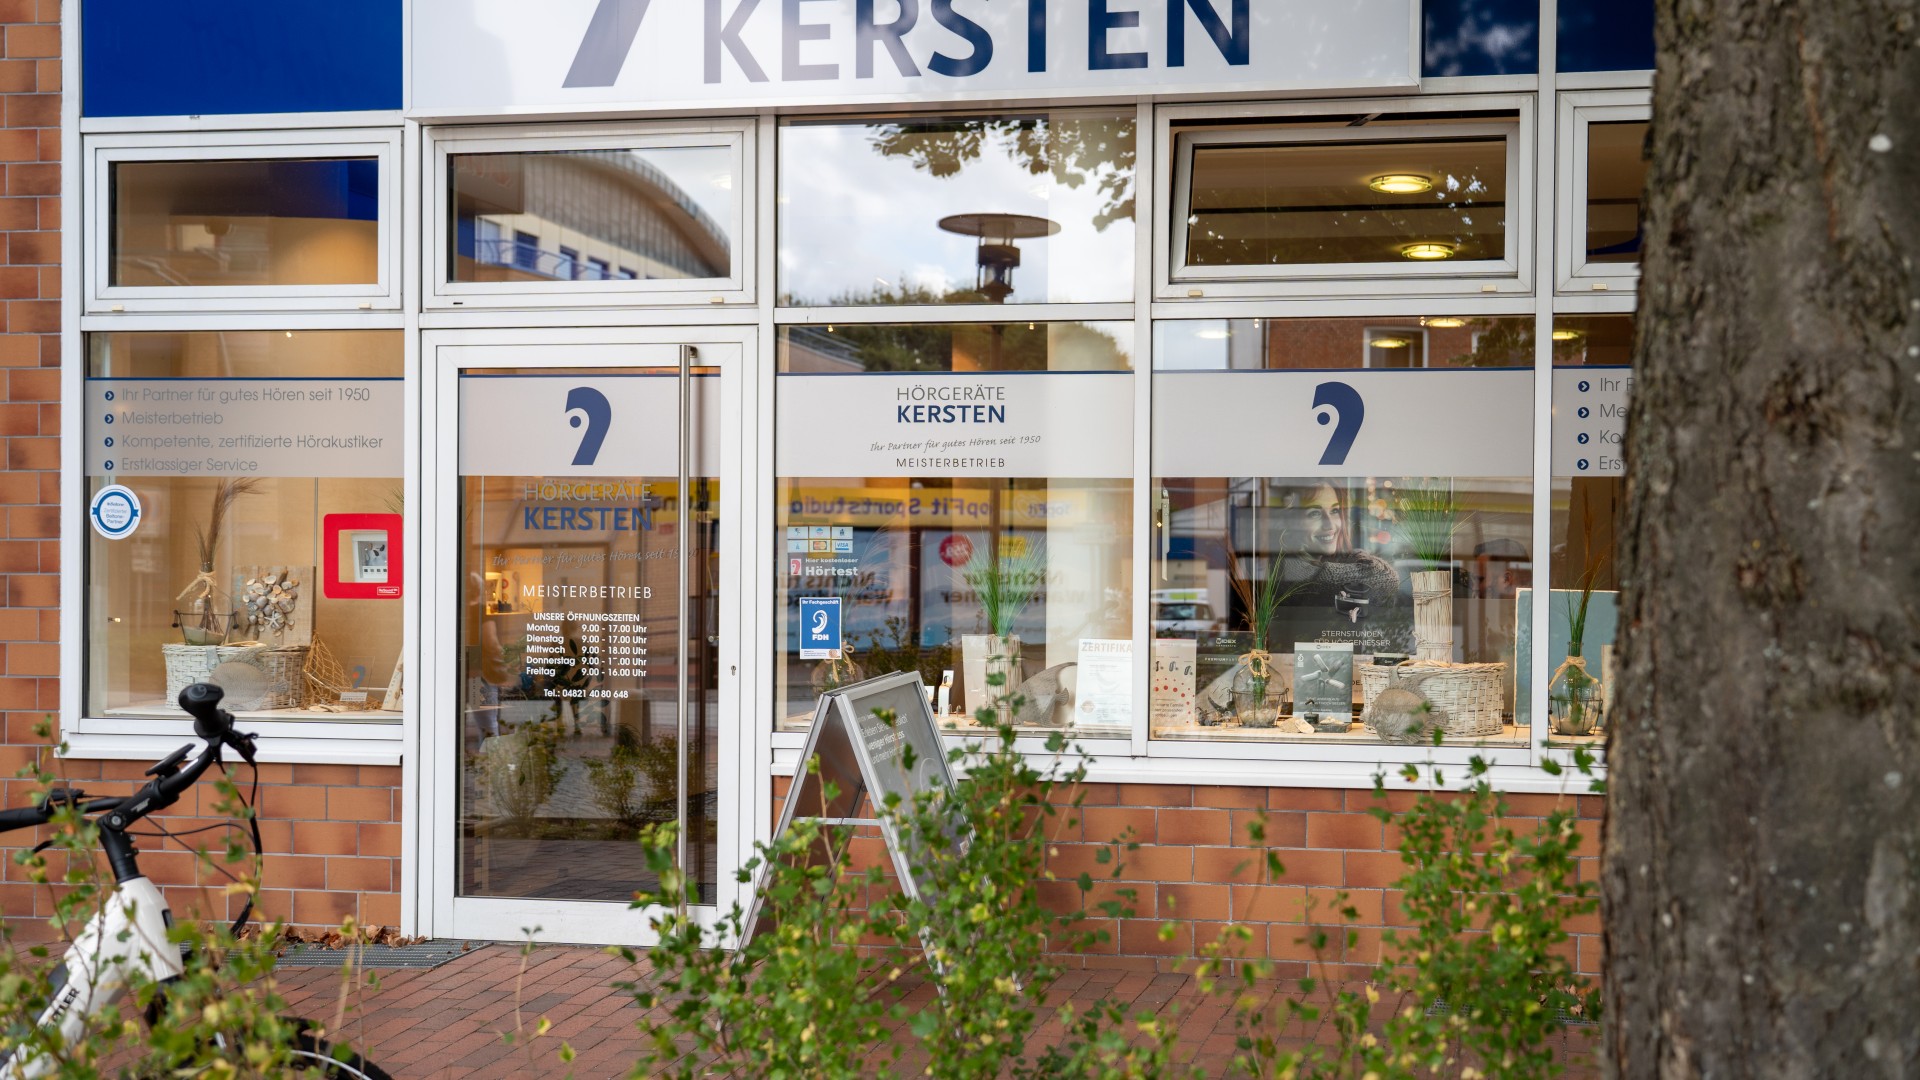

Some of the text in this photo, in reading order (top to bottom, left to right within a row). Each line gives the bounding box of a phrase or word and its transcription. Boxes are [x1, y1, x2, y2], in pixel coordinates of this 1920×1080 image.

[1600, 378, 1620, 391] Ihr
[122, 387, 370, 404] Ihr Partner für gutes Hören seit 1950
[897, 384, 1005, 401] HÖRGERÄTE
[122, 411, 224, 425] Meisterbetrieb
[897, 405, 1005, 423] KERSTEN
[122, 435, 383, 449] Kompetente, zertifizierte Hörakustiker
[870, 435, 1041, 453] Ihr Partner für gutes Hören seit 1950
[122, 457, 258, 473] Erstklassiger Service
[896, 458, 1005, 468] MEISTERBETRIEB
[524, 480, 652, 502] HÖRGERÄTE
[524, 507, 652, 531] KERSTEN
[806, 566, 858, 576] Hörtest
[523, 585, 652, 598] MEISTERBETRIEB
[534, 611, 640, 622] UNSERE ÖFFNUNGSZEITEN
[526, 623, 560, 633] Montag
[581, 624, 599, 632] 9.00
[609, 625, 630, 633] 17.00
[632, 625, 647, 633] Uhr
[526, 634, 564, 644] Dienstag
[581, 635, 599, 643] 9.00
[609, 636, 630, 644] 17.00
[632, 636, 647, 644] Uhr
[526, 645, 565, 653] Mittwoch
[581, 646, 599, 654] 9.00
[609, 647, 630, 655] 18.00
[632, 647, 647, 655] Uhr
[1082, 643, 1132, 652] ZERTIFIKA
[526, 656, 576, 666] Donnerstag
[581, 657, 599, 665] 9.00
[632, 658, 647, 666] Uhr
[526, 667, 556, 677] Freitag
[581, 668, 599, 676] 9.00
[609, 669, 630, 677] 16.00
[632, 669, 647, 677] Uhr
[544, 689, 560, 697] Tel.:
[562, 689, 586, 697] 04821
[613, 690, 628, 698] 648
